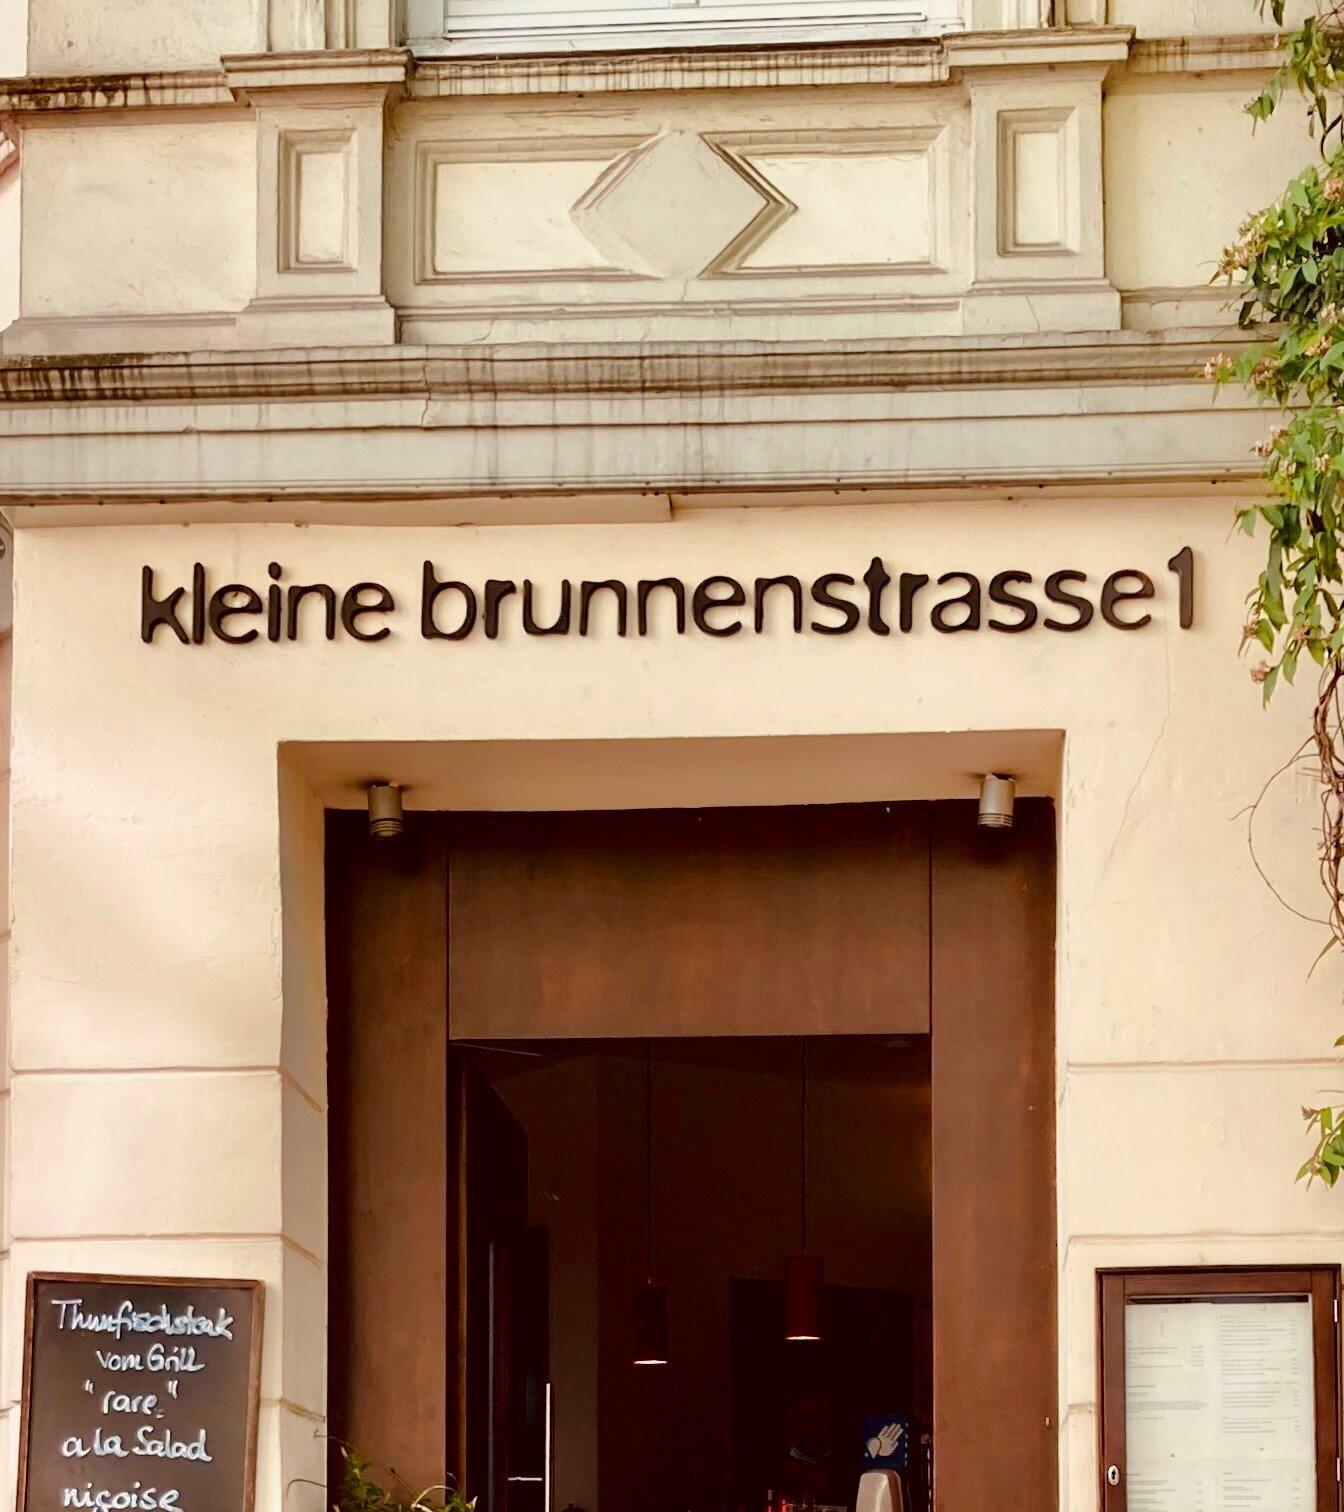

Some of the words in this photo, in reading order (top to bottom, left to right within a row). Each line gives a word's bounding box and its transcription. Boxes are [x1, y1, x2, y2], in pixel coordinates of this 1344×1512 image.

[140, 561, 396, 646] kleine
[96, 1350, 144, 1371] vom
[147, 1343, 205, 1372] Grill
[62, 1436, 92, 1457] a
[94, 1427, 130, 1458] la
[132, 1425, 213, 1462] Salad
